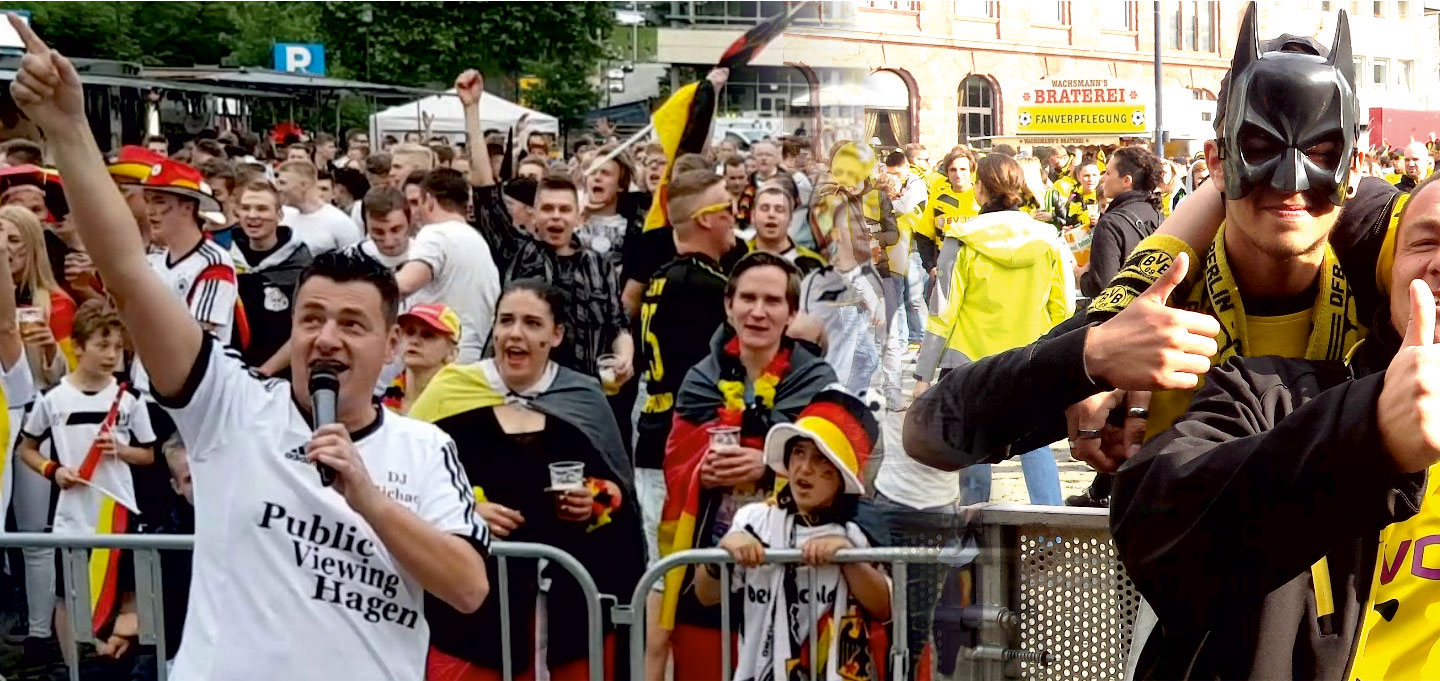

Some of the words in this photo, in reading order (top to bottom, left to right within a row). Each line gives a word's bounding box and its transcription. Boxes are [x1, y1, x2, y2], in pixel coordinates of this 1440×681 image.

[1034, 88, 1126, 104] BRATEREI
[1051, 79, 1108, 88] WACHSMANN'S
[1035, 114, 1127, 124] FANVERPFLEGUNG
[1329, 263, 1346, 308] DFB
[388, 471, 408, 485] DJ
[257, 501, 375, 557] Public
[291, 540, 400, 599] Viewing
[311, 573, 419, 629] Hagen
